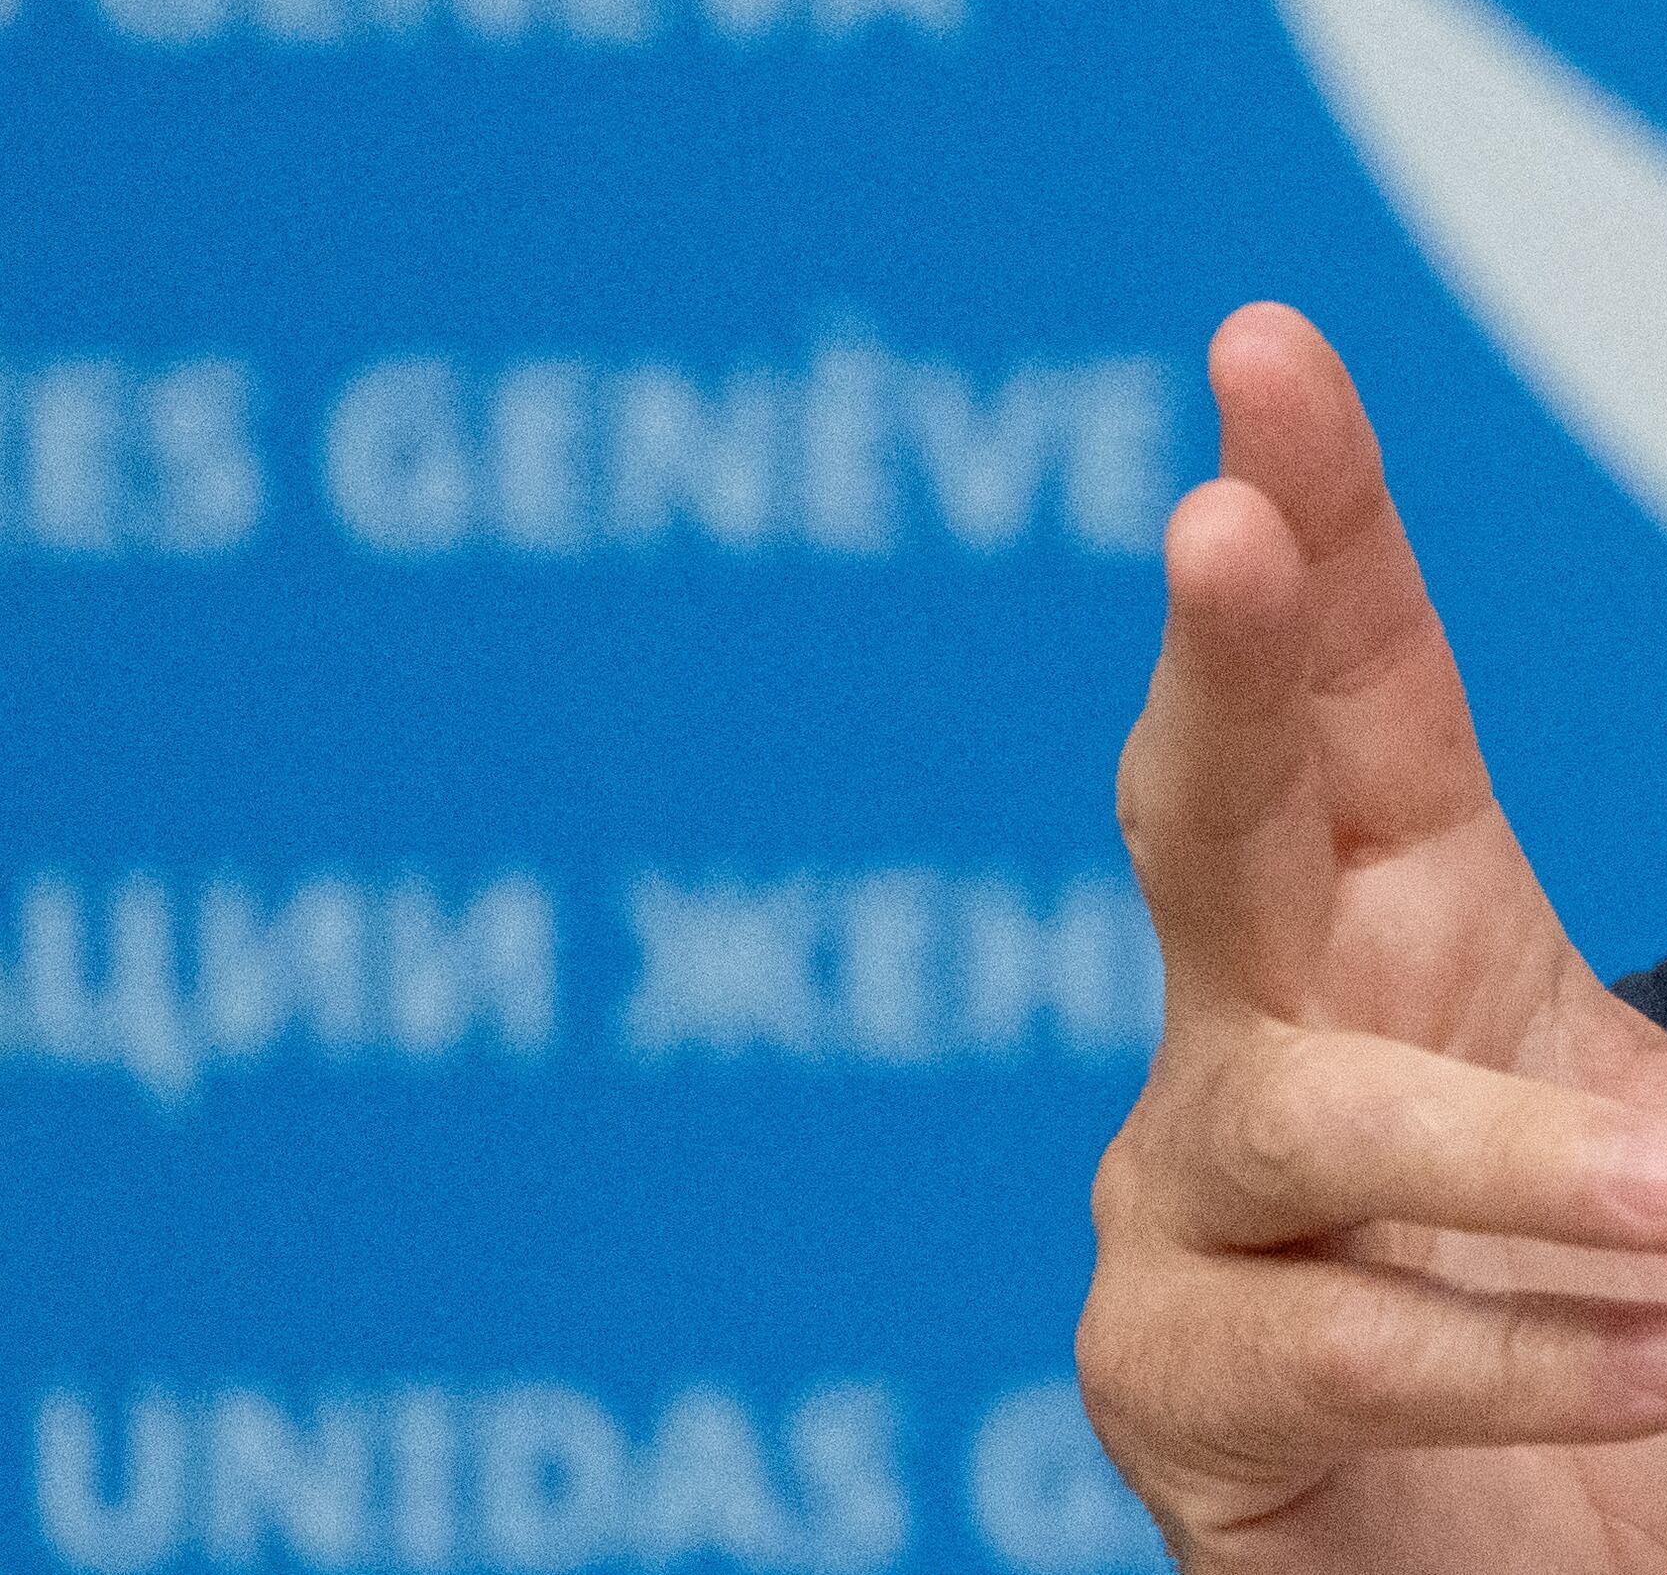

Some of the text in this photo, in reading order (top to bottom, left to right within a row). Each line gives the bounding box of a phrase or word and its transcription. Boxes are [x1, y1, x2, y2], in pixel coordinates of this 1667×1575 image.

[0, 314, 1172, 552] ES GENÈVE
[0, 874, 556, 1102] ЦИИ
[38, 1386, 906, 1575] UNIDAS
